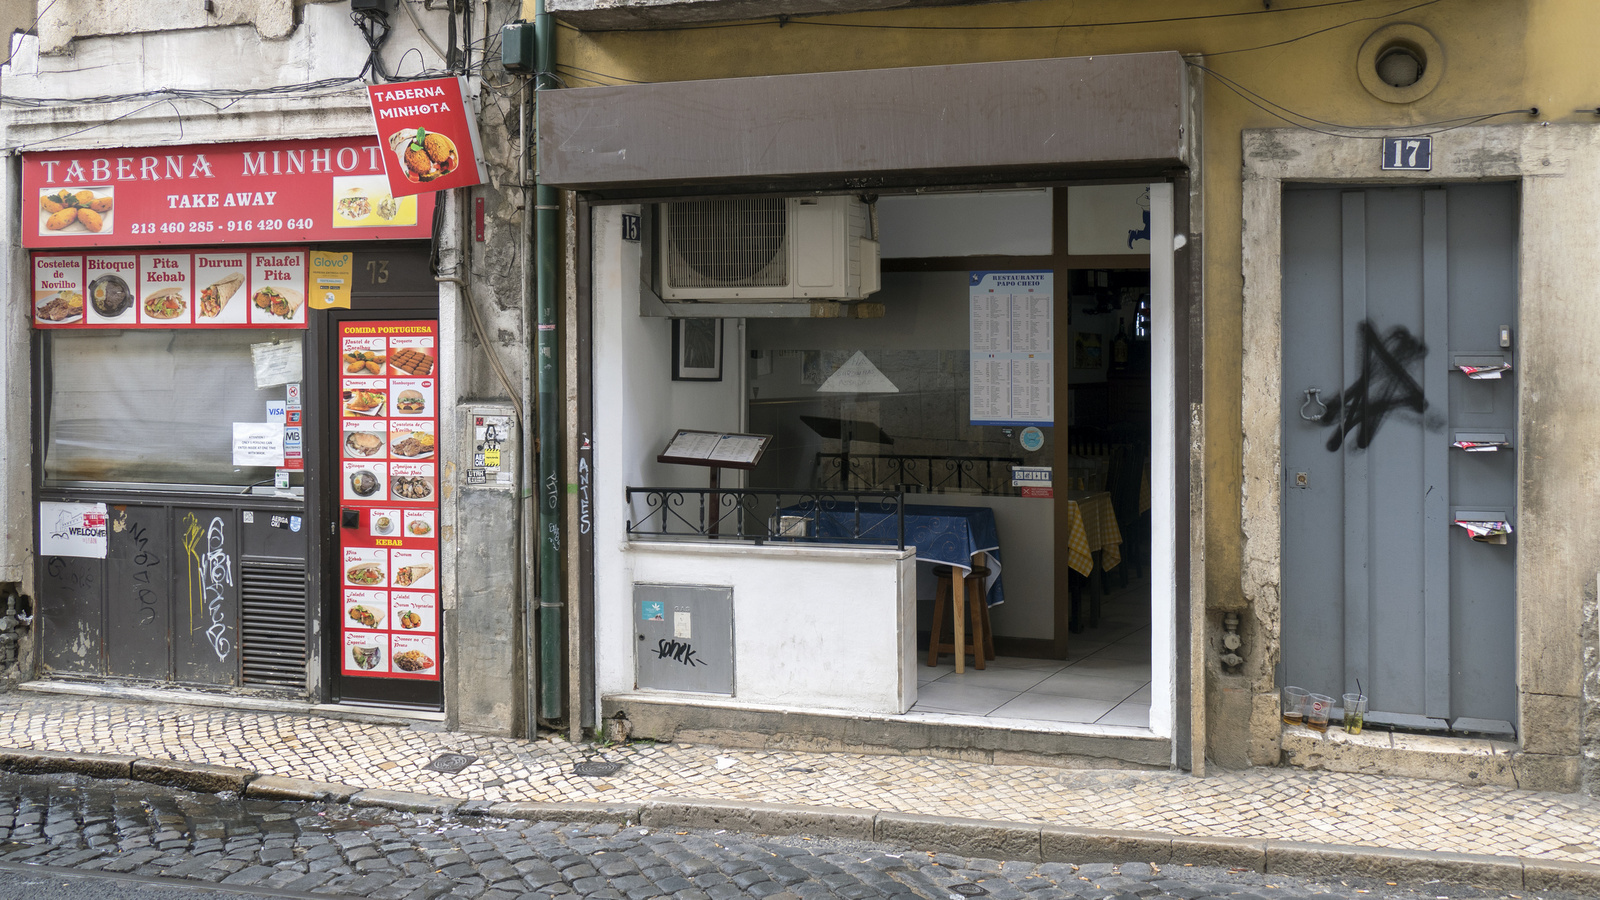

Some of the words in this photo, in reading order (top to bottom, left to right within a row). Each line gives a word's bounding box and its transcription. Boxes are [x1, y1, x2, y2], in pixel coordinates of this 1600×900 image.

[374, 86, 445, 102] TABERNA
[379, 102, 451, 119] MINHOTA
[1394, 140, 1420, 167] 17
[40, 154, 215, 183] TABERNA
[242, 145, 380, 176] MINHOT
[167, 193, 219, 209] TAKE
[224, 191, 277, 207] AWAY
[131, 223, 156, 234] 213
[160, 222, 185, 233] 460
[189, 221, 214, 232] 285
[227, 220, 253, 231] 916
[257, 219, 283, 230] 420
[287, 218, 313, 229] 640
[625, 216, 637, 240] 15
[37, 259, 80, 268] Costeleta
[88, 259, 135, 272] Bitoque
[152, 258, 179, 269] Pita
[199, 257, 243, 268] Durum
[256, 256, 300, 267] Falafel
[314, 258, 344, 268] Glovo
[53, 270, 64, 278] de
[146, 271, 186, 282] Kebab
[264, 269, 292, 280] Pita
[41, 280, 76, 289] Novilho
[269, 408, 285, 416] VISA
[286, 432, 300, 441] MB
[579, 457, 590, 534] ANTES
